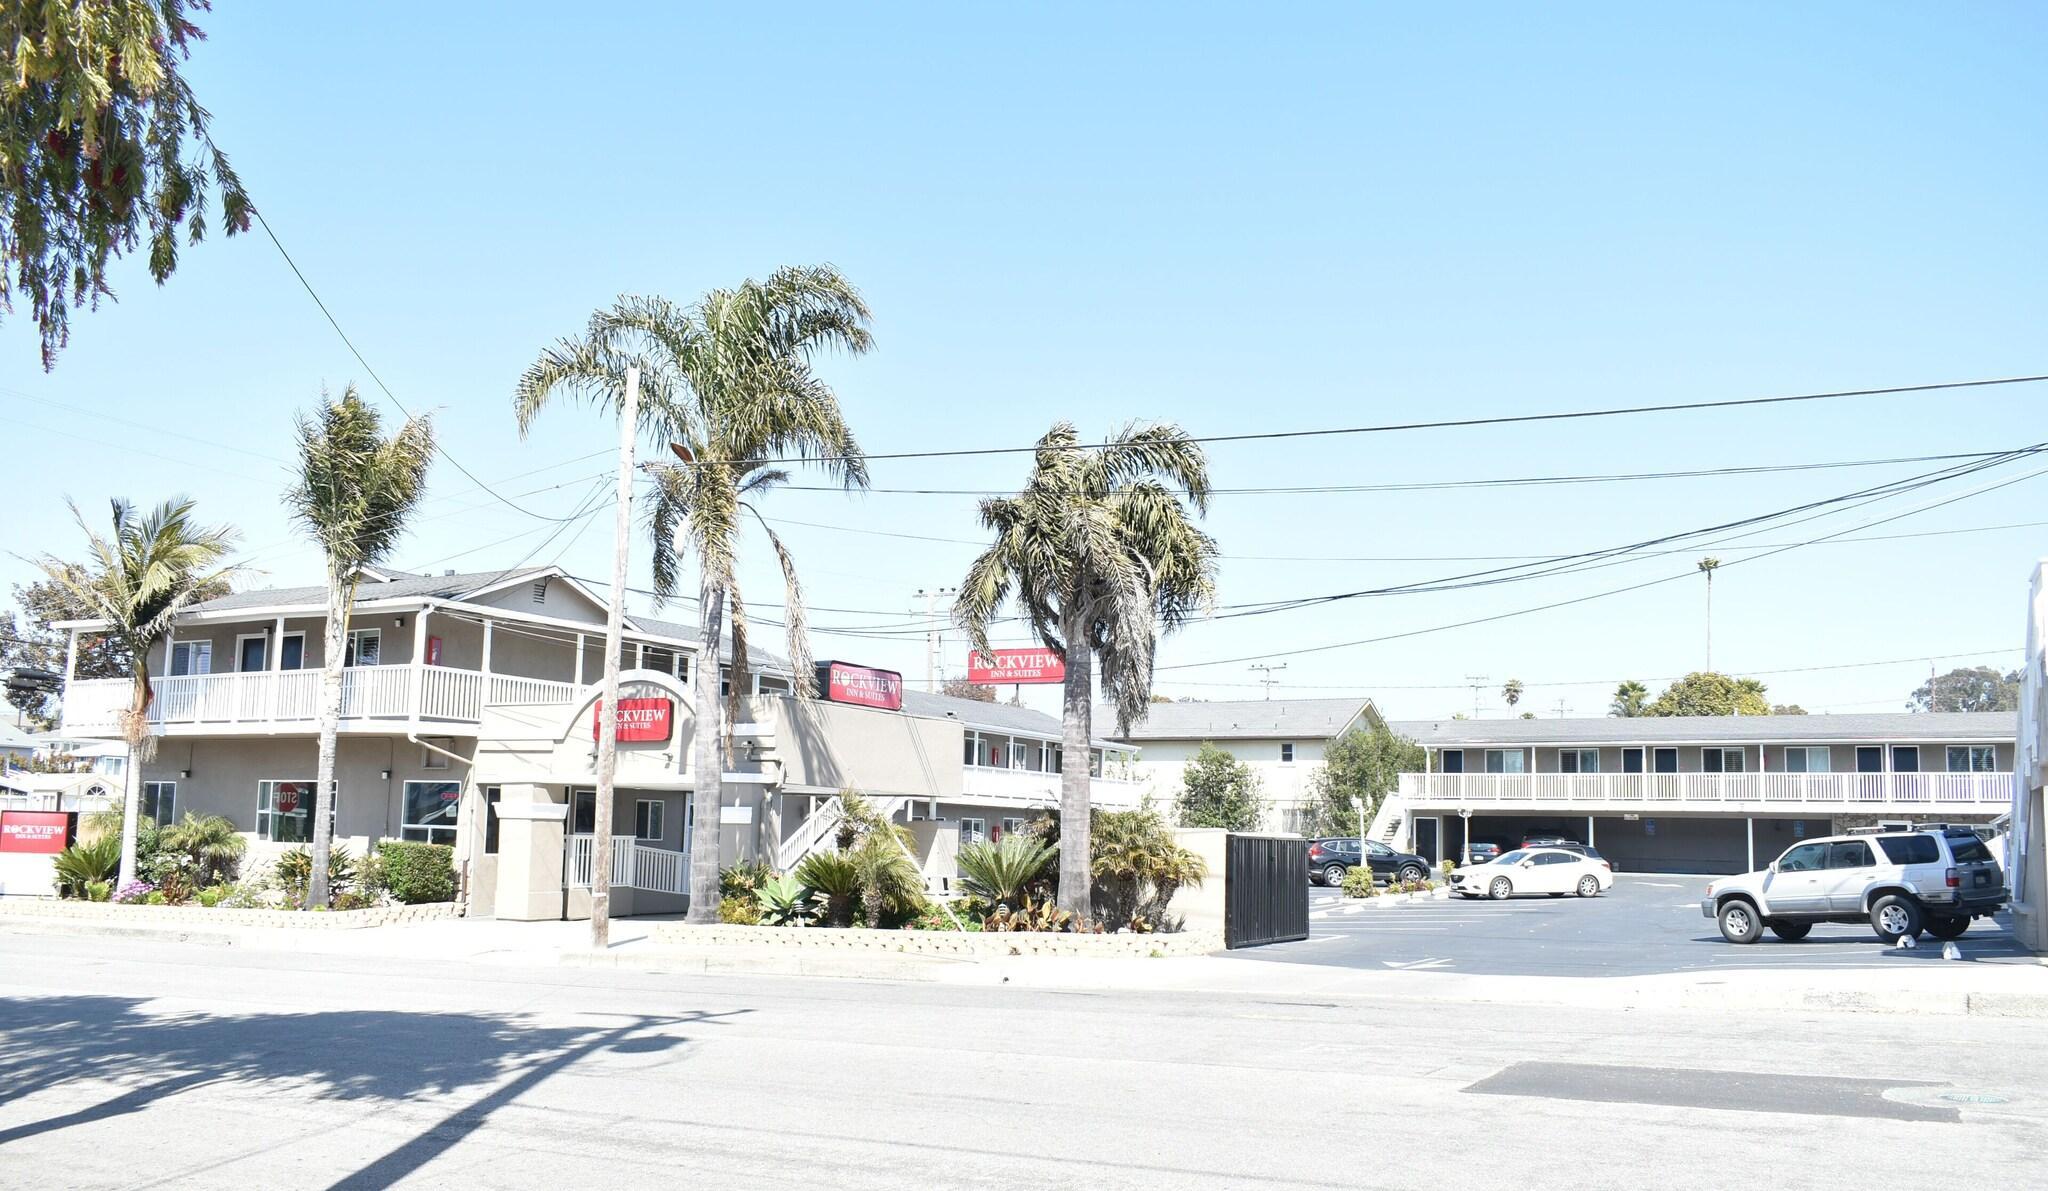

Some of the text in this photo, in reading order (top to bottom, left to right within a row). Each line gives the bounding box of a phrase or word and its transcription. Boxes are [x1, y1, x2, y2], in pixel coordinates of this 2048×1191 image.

[991, 670, 1005, 678] INN
[1013, 669, 1041, 677] SUITES
[832, 669, 898, 695] ROCKVIEW
[846, 688, 859, 698] INN
[864, 691, 885, 700] SUITES
[598, 709, 666, 722] CKVIEW
[3, 824, 65, 835] ROCKVIEW
